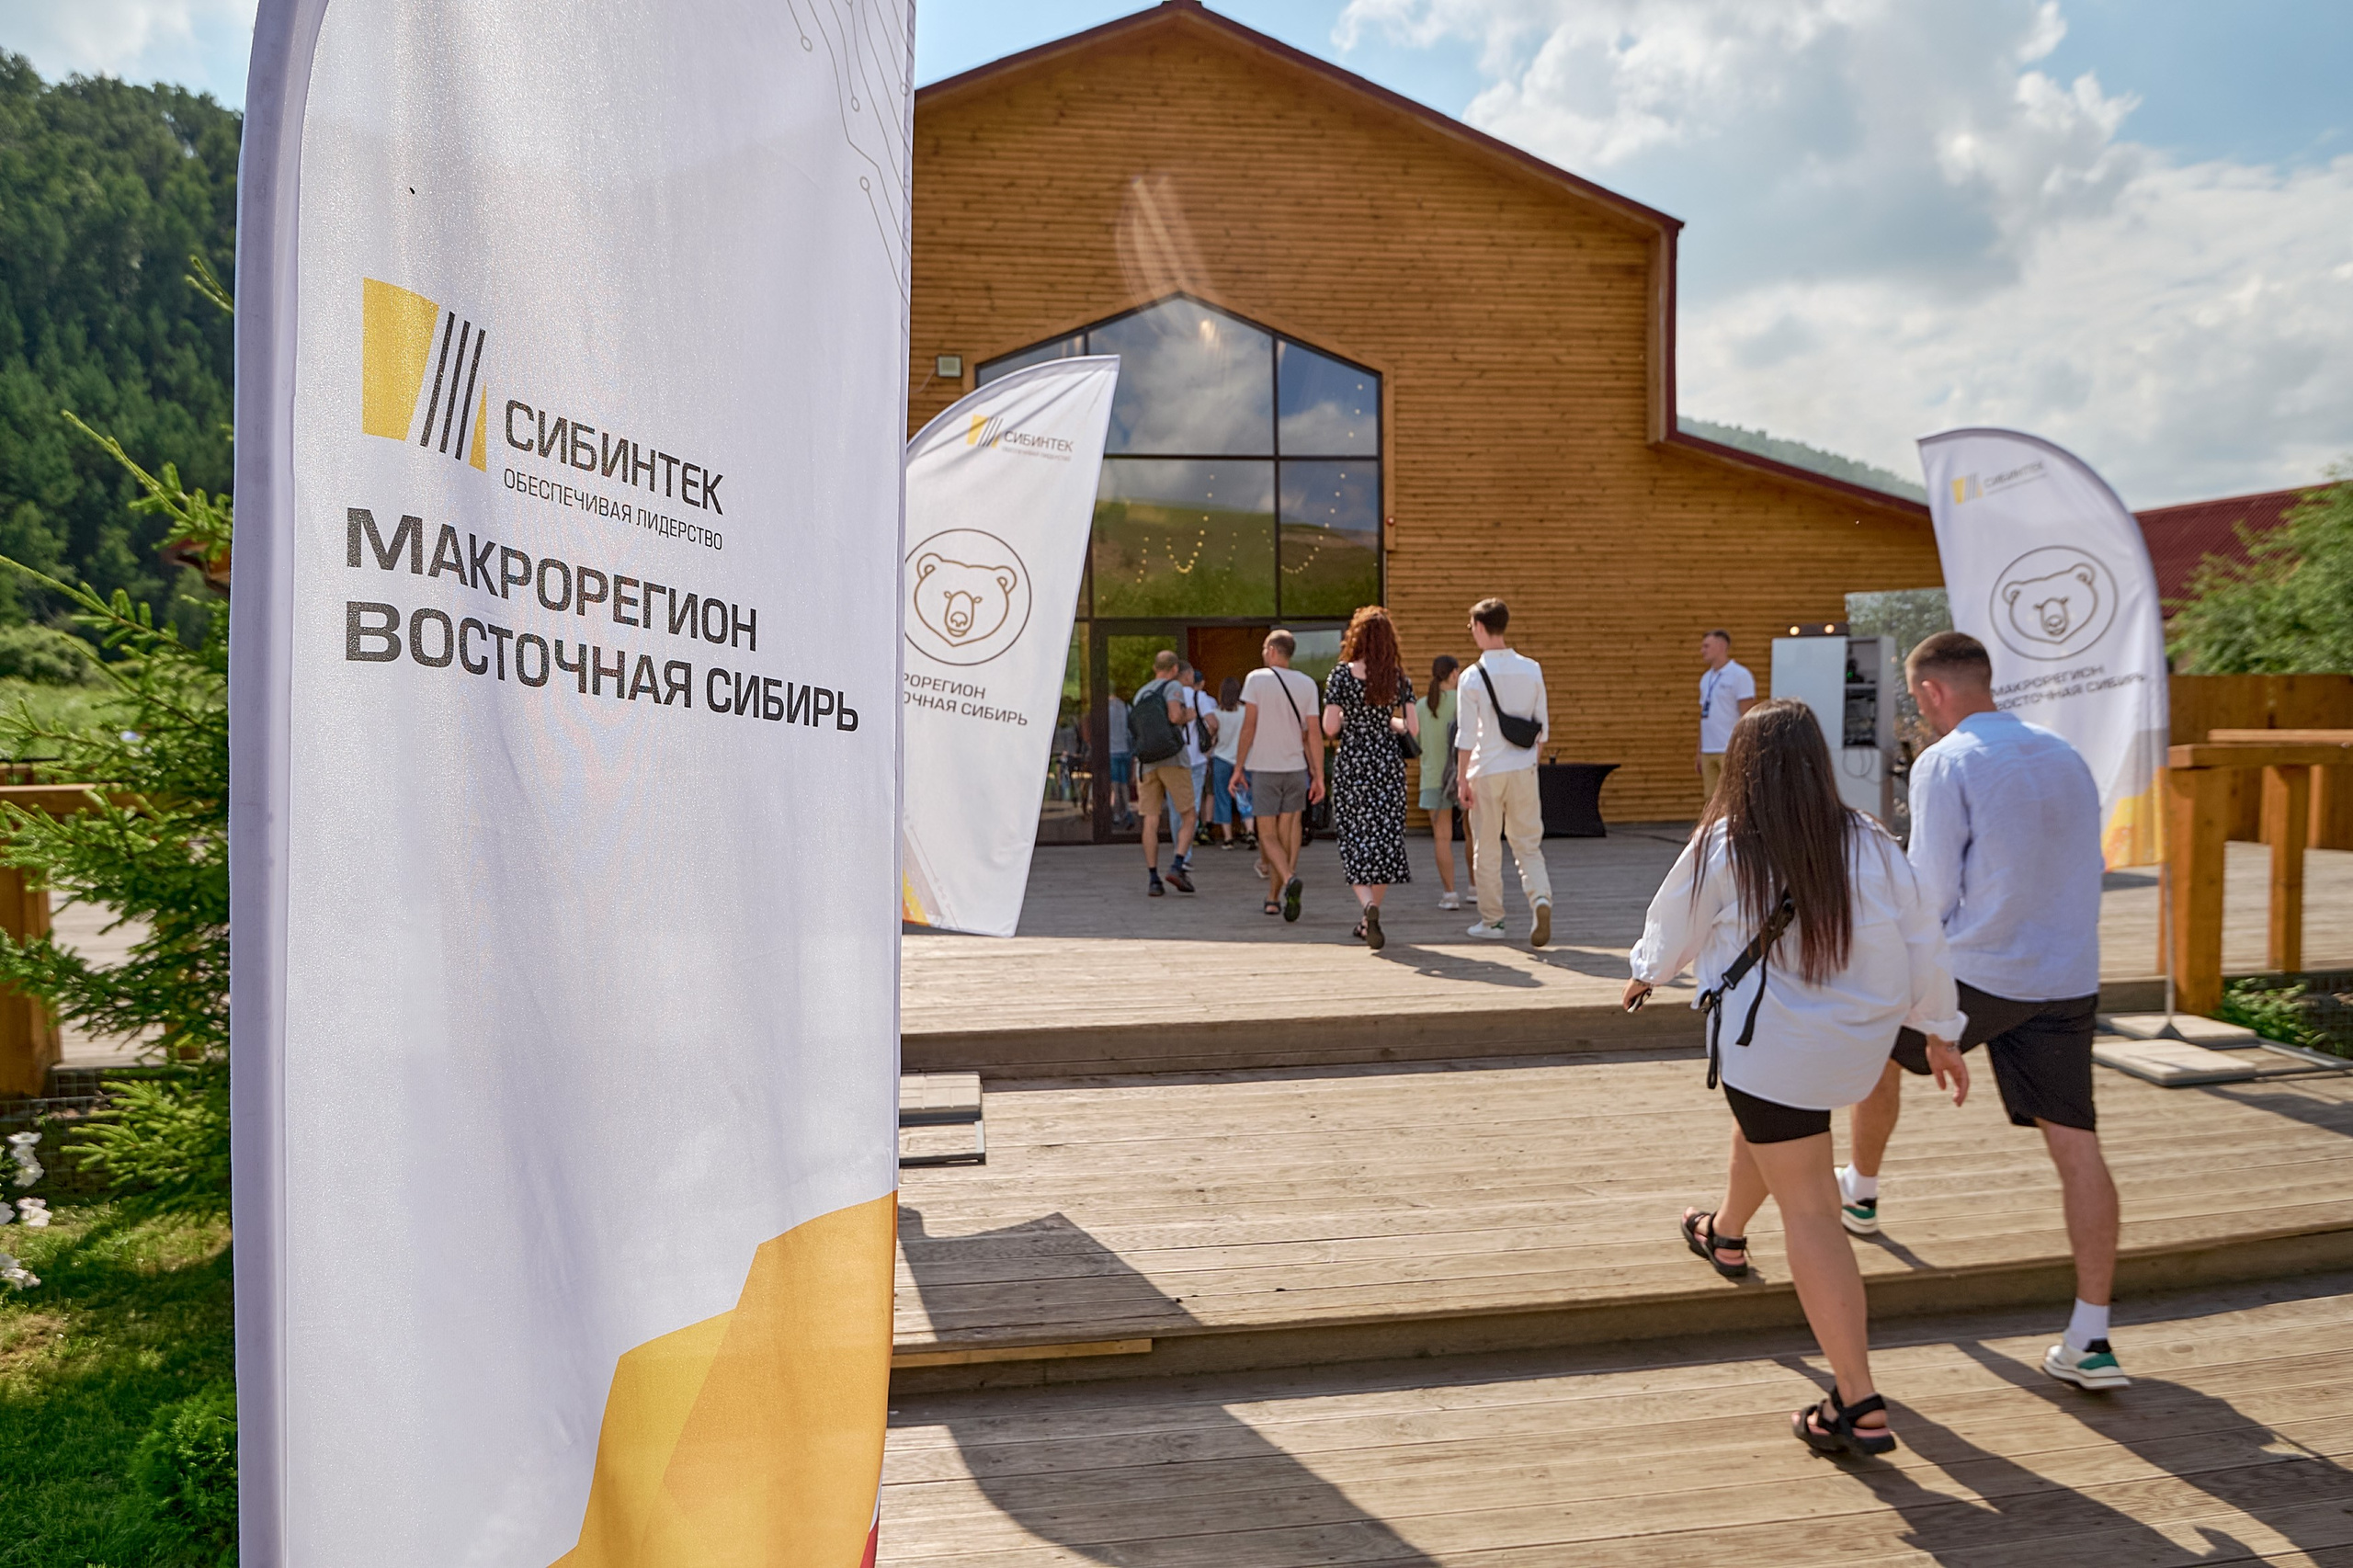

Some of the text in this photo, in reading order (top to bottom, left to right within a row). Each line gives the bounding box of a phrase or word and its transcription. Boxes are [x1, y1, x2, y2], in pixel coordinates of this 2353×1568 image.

[506, 399, 723, 516] СИБИНТЕК
[1004, 430, 1074, 452] СИБИНТЕК
[504, 468, 723, 551] ОБЕСПЕЧИВАЯ ЛИДЕРСТВО
[346, 506, 757, 653] МАКРОРЕГИОН
[346, 600, 859, 733] ВОСТОЧНАЯ СИБИРЬ
[961, 702, 1028, 726] СИБИРЬ
